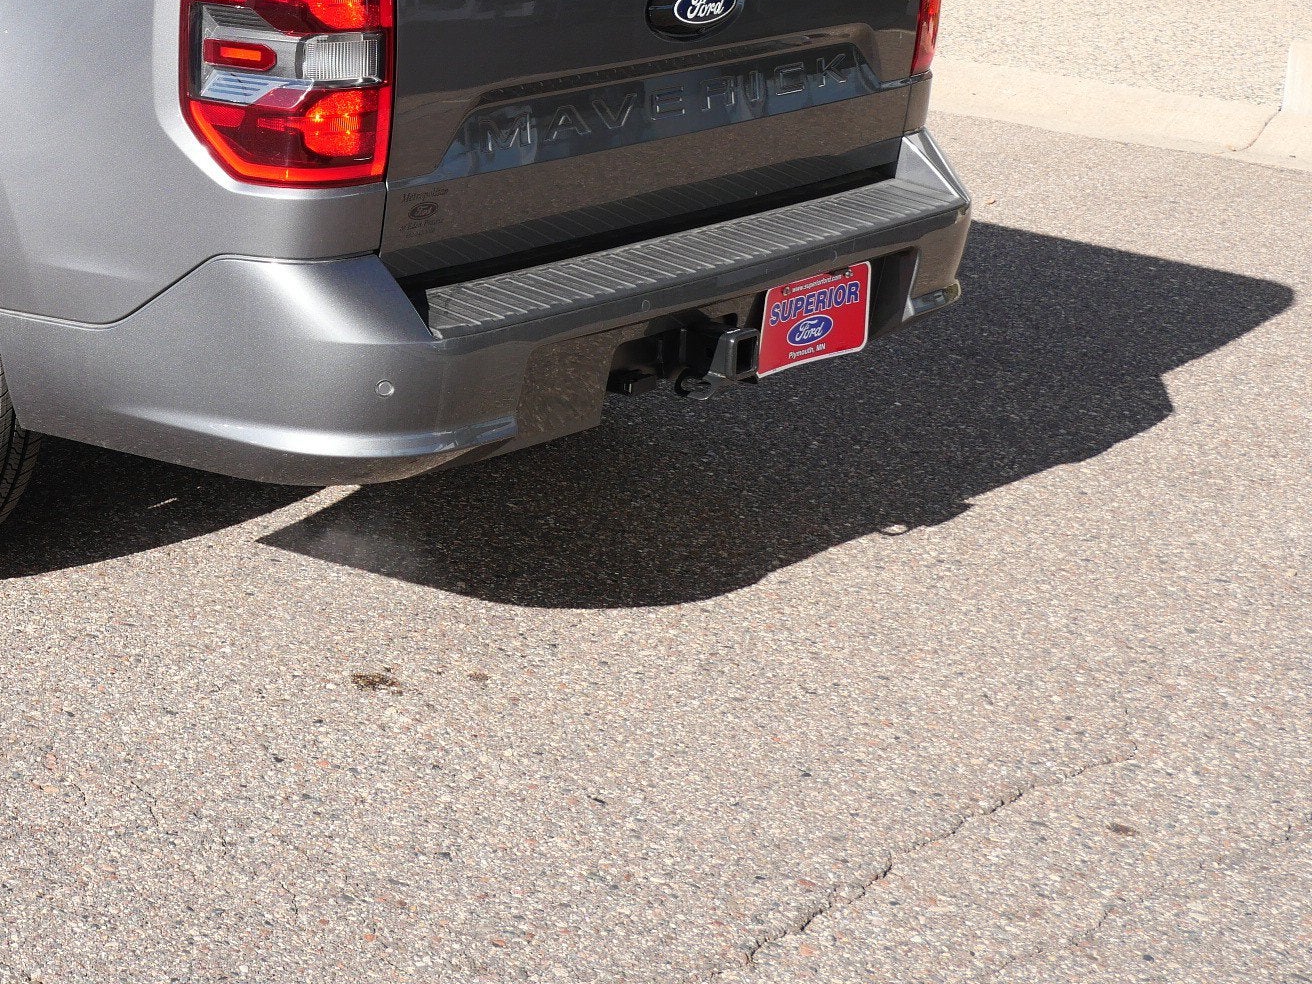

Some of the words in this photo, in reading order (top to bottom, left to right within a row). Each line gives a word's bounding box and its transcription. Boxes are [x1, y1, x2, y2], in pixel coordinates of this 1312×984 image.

[478, 52, 849, 152] MAVERICK
[769, 280, 860, 327] SUPERIOR
[792, 317, 827, 343] Ford
[815, 343, 826, 351] MN
